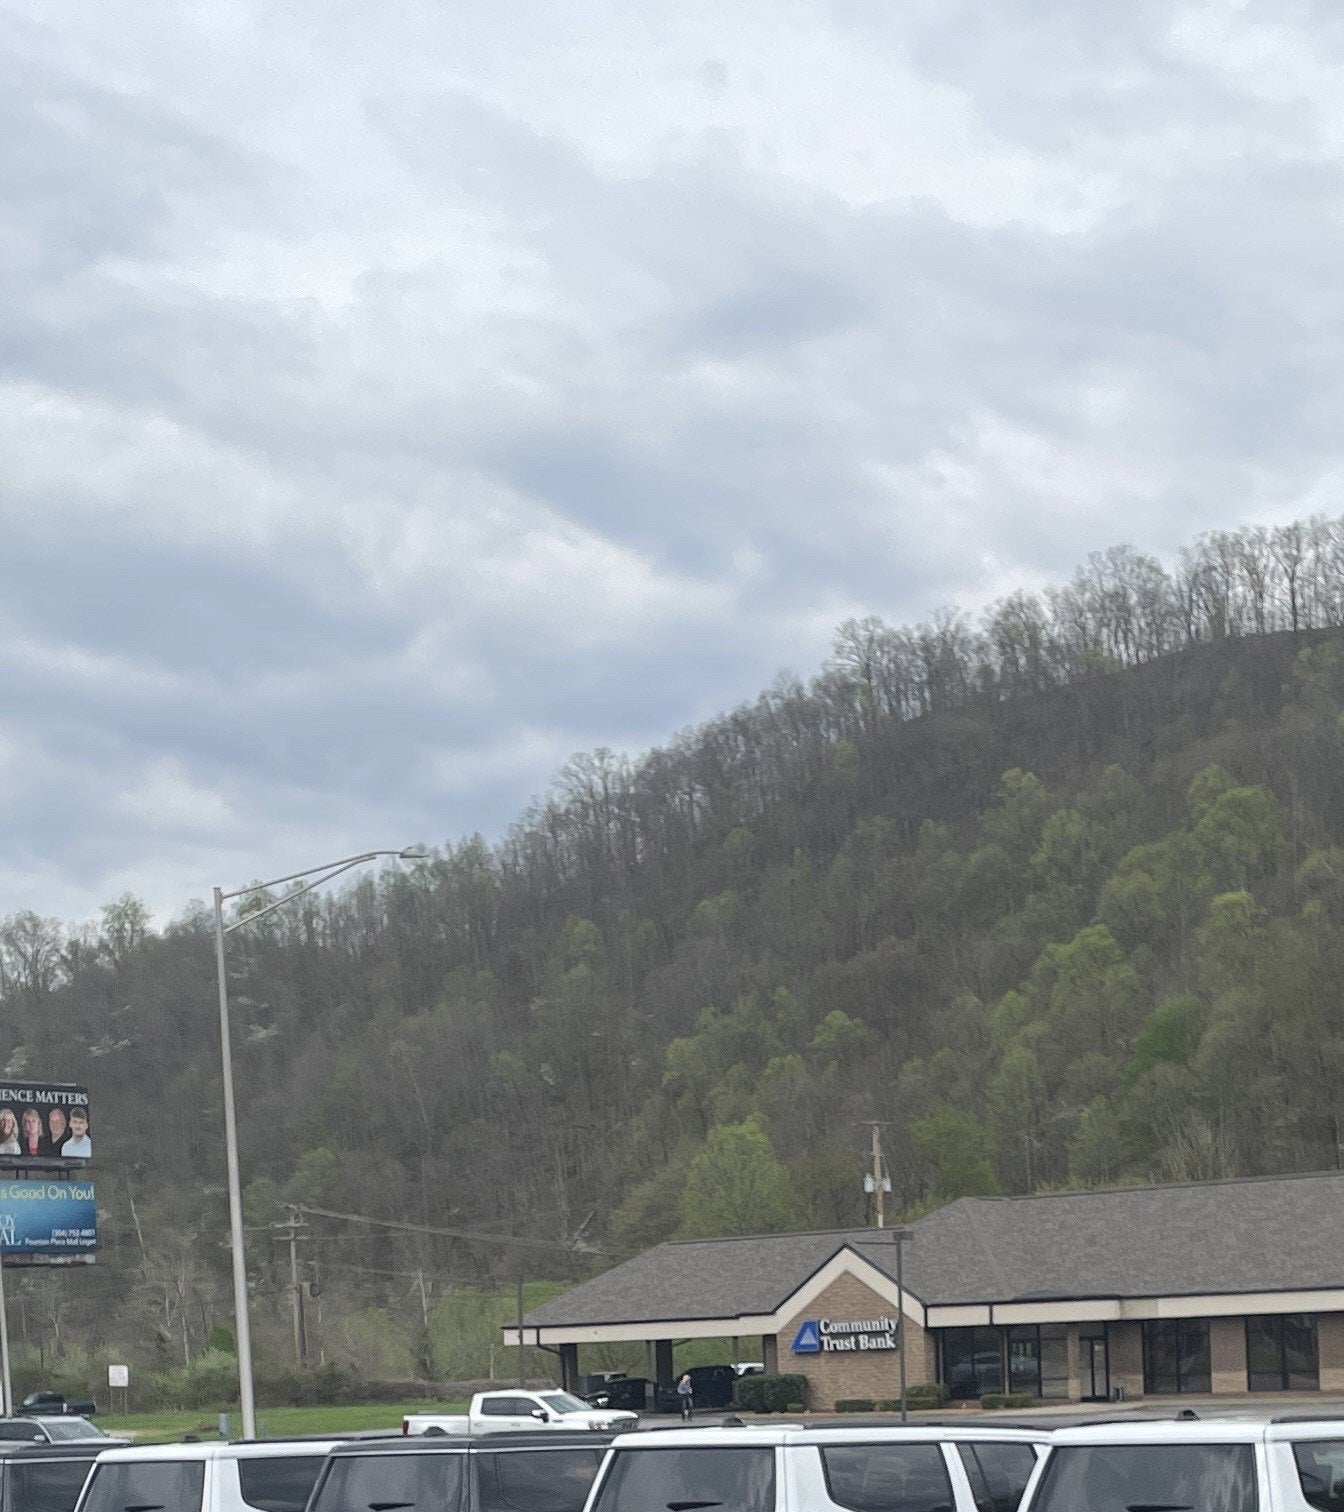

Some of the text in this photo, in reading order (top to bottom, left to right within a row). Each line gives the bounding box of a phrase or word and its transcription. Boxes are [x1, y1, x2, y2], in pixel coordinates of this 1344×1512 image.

[36, 1090, 89, 1106] MATTERS
[9, 1184, 45, 1200] Good
[47, 1185, 67, 1199] On
[69, 1185, 95, 1200] You!
[819, 1315, 896, 1335] Community
[820, 1333, 896, 1351] Trust Bank
